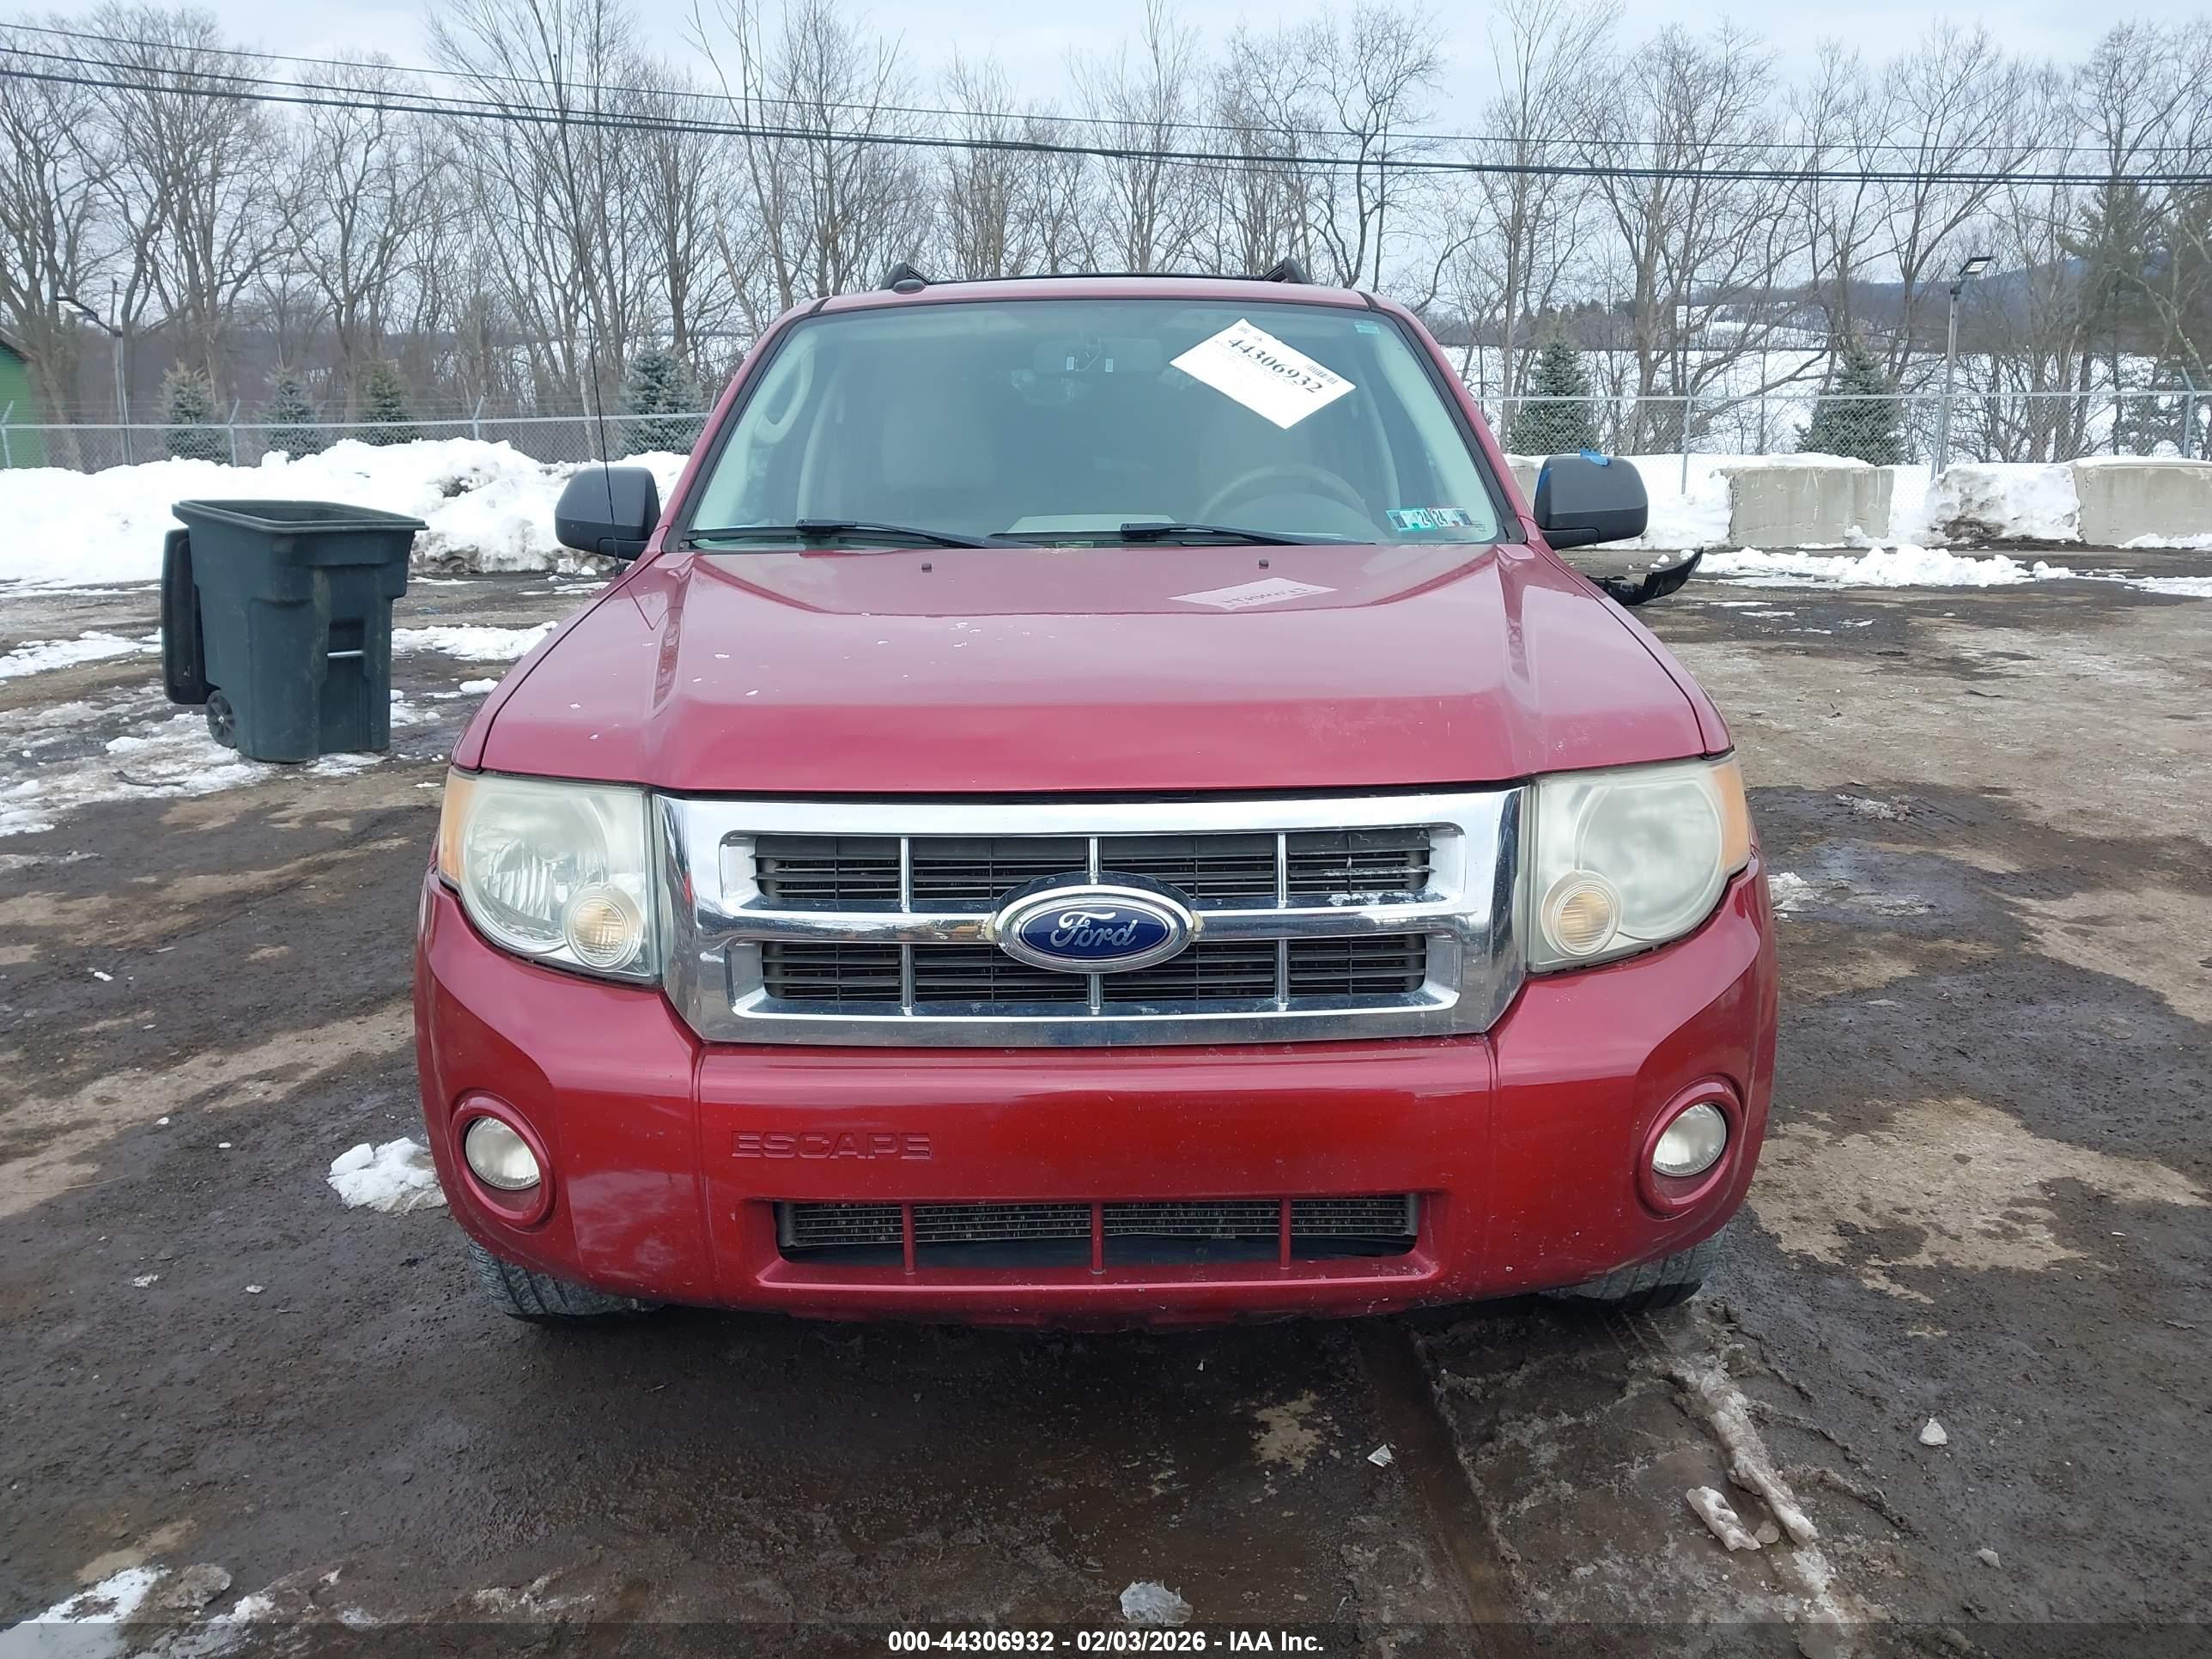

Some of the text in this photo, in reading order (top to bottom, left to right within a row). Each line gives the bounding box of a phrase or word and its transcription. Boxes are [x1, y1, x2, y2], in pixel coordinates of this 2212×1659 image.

[1228, 338, 1323, 393] 44306932
[1050, 911, 1138, 948] Ford
[731, 1131, 933, 1159] ESCAPE
